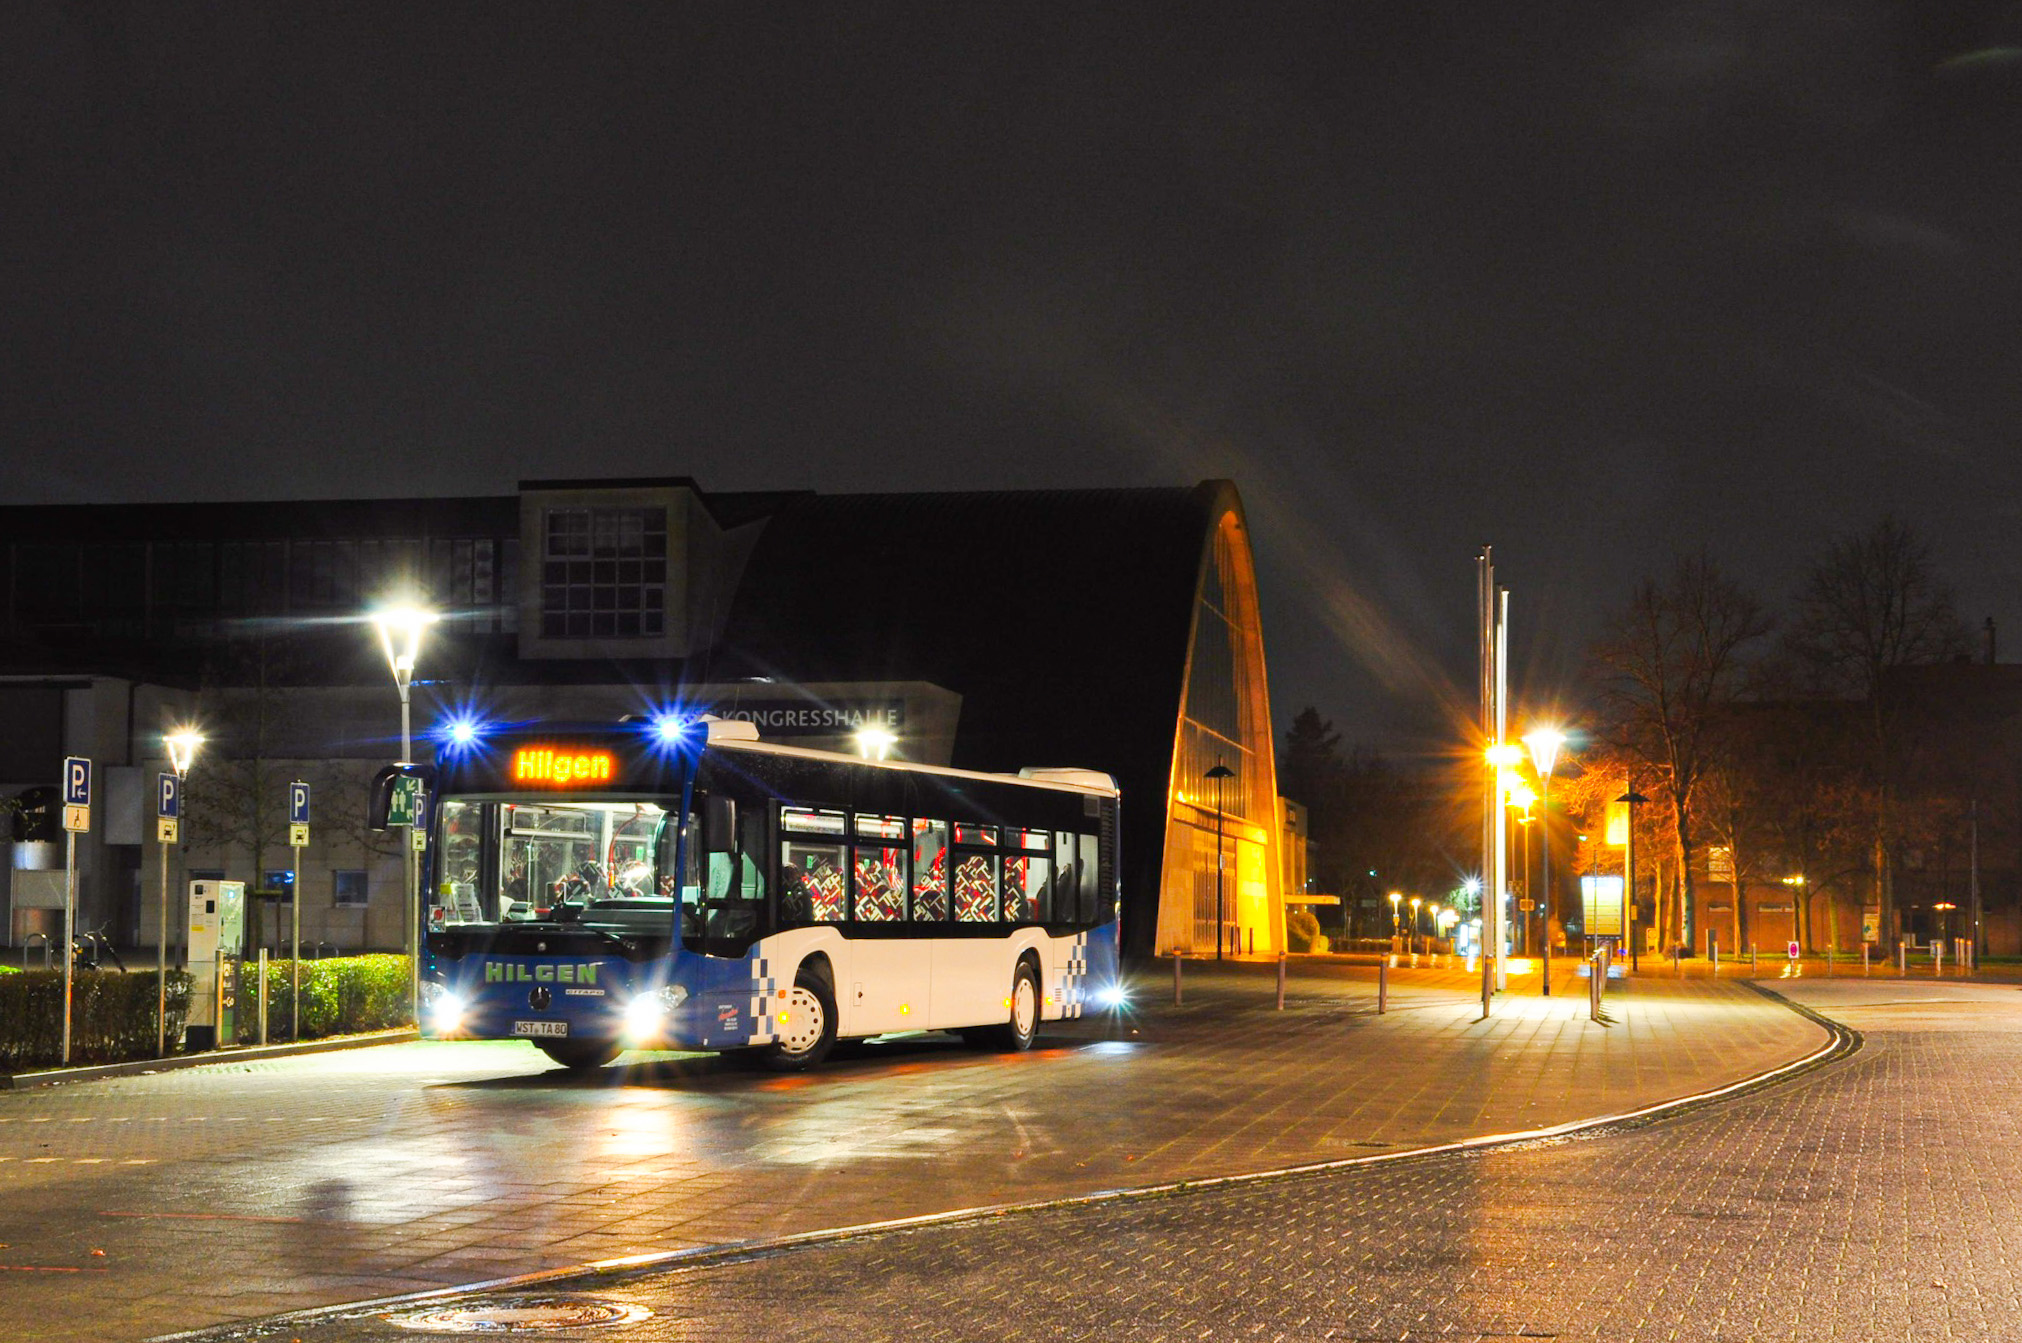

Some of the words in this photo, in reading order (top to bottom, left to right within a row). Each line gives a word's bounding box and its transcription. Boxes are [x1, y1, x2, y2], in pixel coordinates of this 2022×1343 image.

[72, 764, 85, 798] P
[517, 750, 610, 783] Hilgen
[162, 779, 175, 811] P
[294, 788, 306, 818] P
[415, 798, 424, 824] P
[485, 961, 597, 984] HILGEN
[516, 1022, 535, 1033] WST
